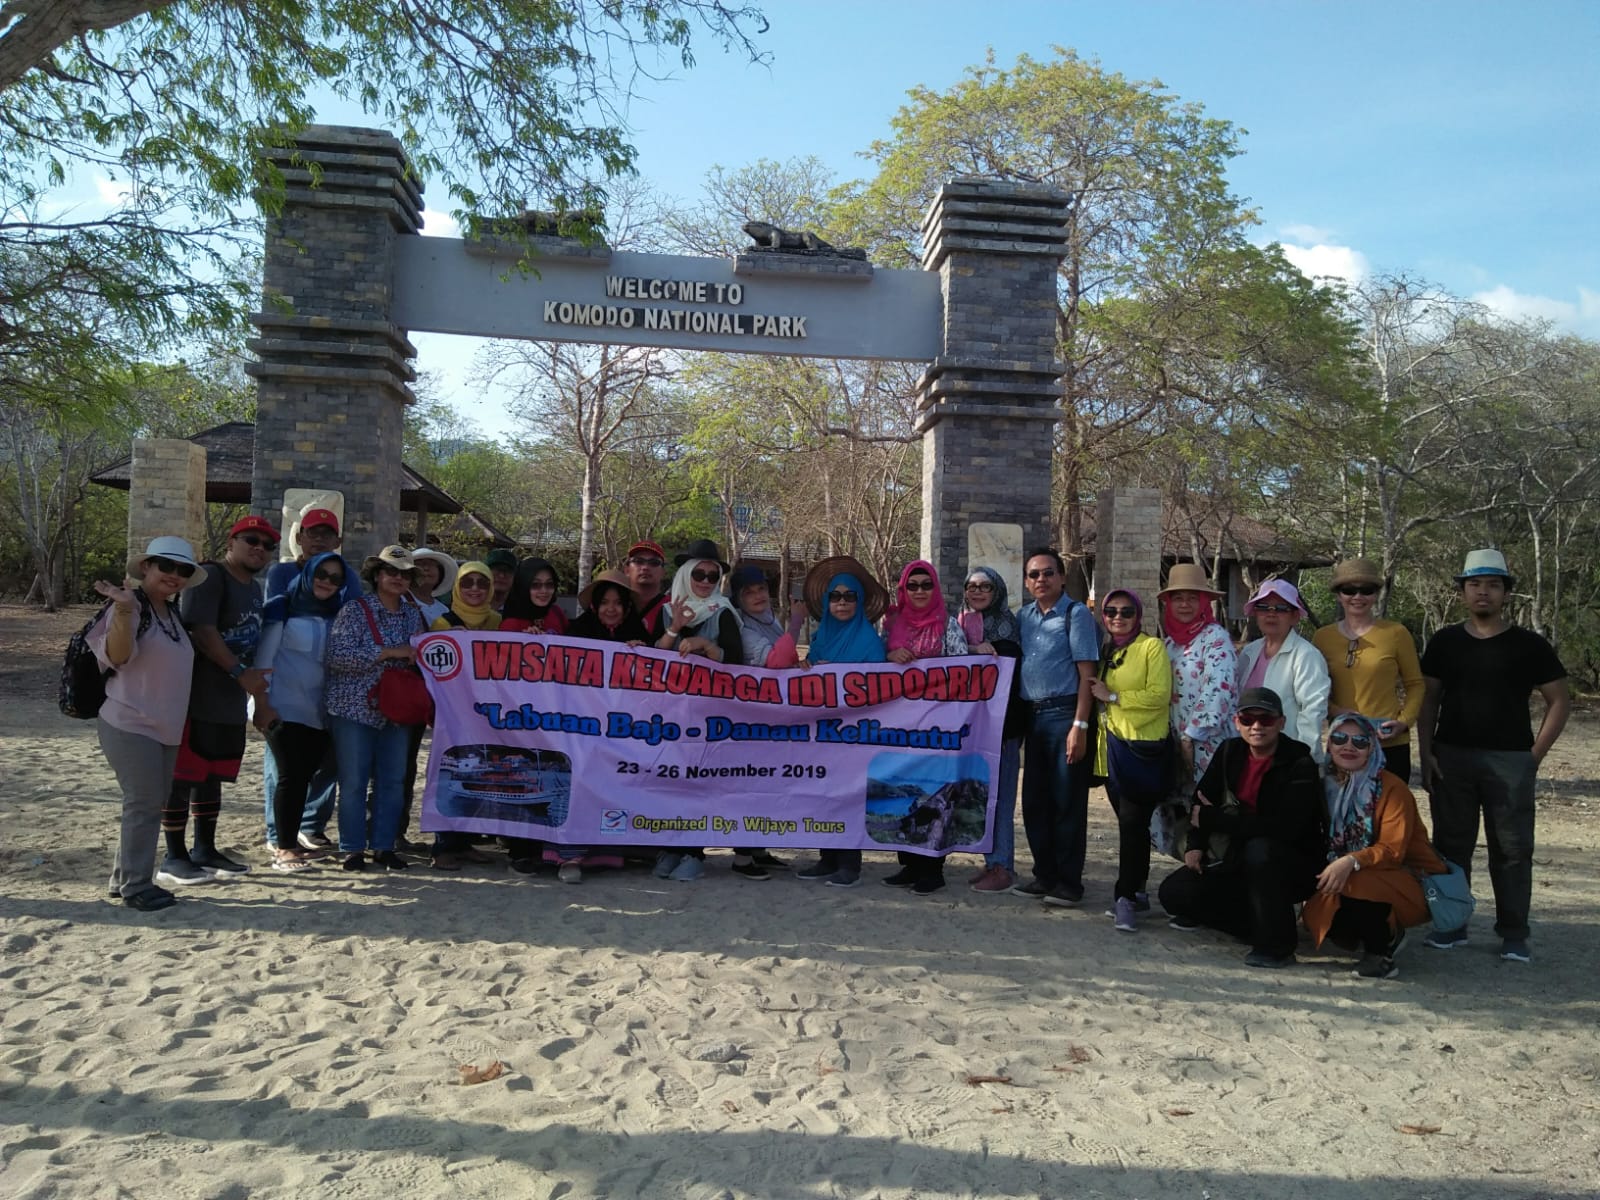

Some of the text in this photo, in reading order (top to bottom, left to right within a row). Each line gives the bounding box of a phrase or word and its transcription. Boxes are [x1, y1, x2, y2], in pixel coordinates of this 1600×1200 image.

[606, 276, 742, 305] WELCOME TO
[543, 301, 807, 337] KOMODO NATIONAL PARK
[472, 641, 999, 708] WISATA KELUARGA IDI SIDOARJO
[607, 712, 680, 746] Bajo
[705, 717, 810, 742] Danau
[616, 761, 640, 774] 23
[656, 765, 679, 778] 26
[686, 764, 776, 779] November
[782, 765, 826, 779] 2019
[632, 815, 845, 835] Organized By: Wijaya Tours
